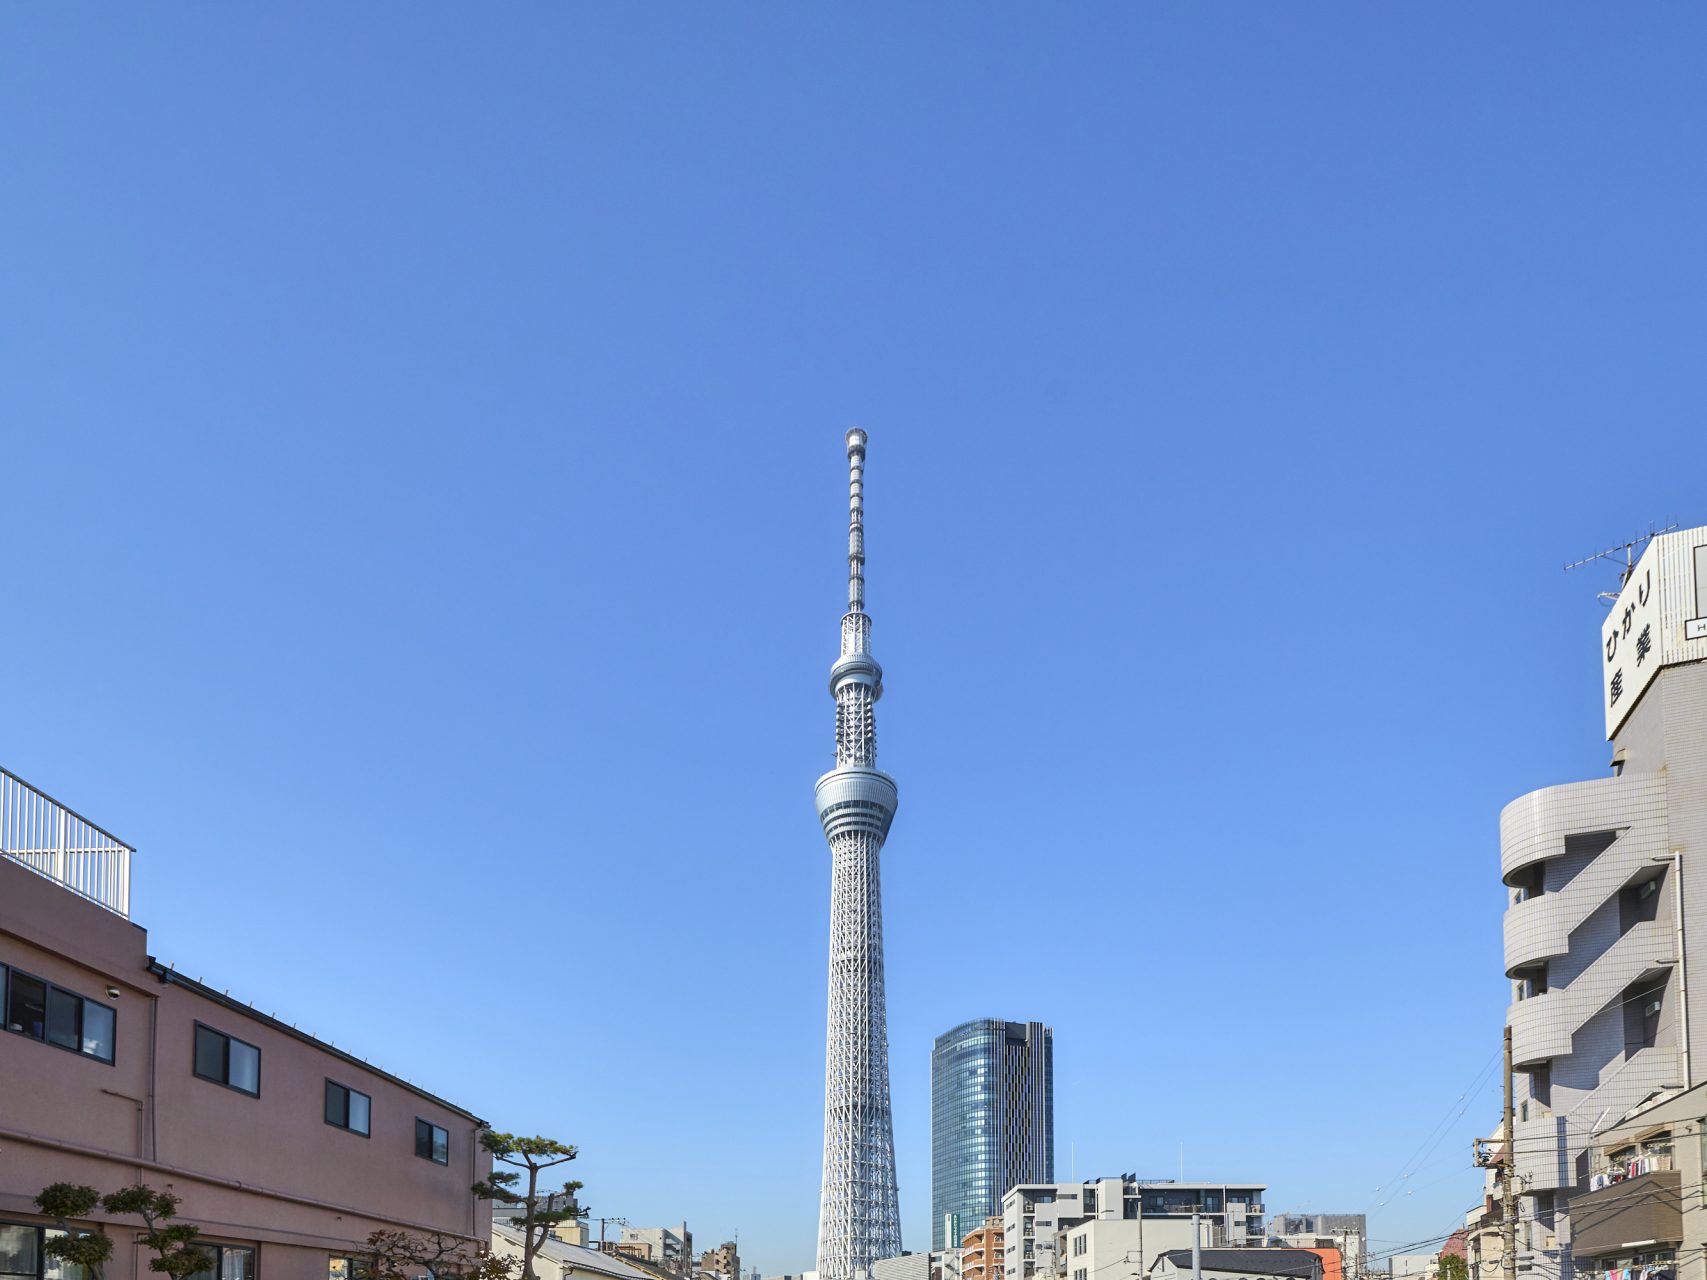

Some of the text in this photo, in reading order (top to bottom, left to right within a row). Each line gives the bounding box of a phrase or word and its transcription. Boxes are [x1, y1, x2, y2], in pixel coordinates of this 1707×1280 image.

[1606, 569, 1651, 662] ひかり
[1610, 623, 1652, 707] 産業
